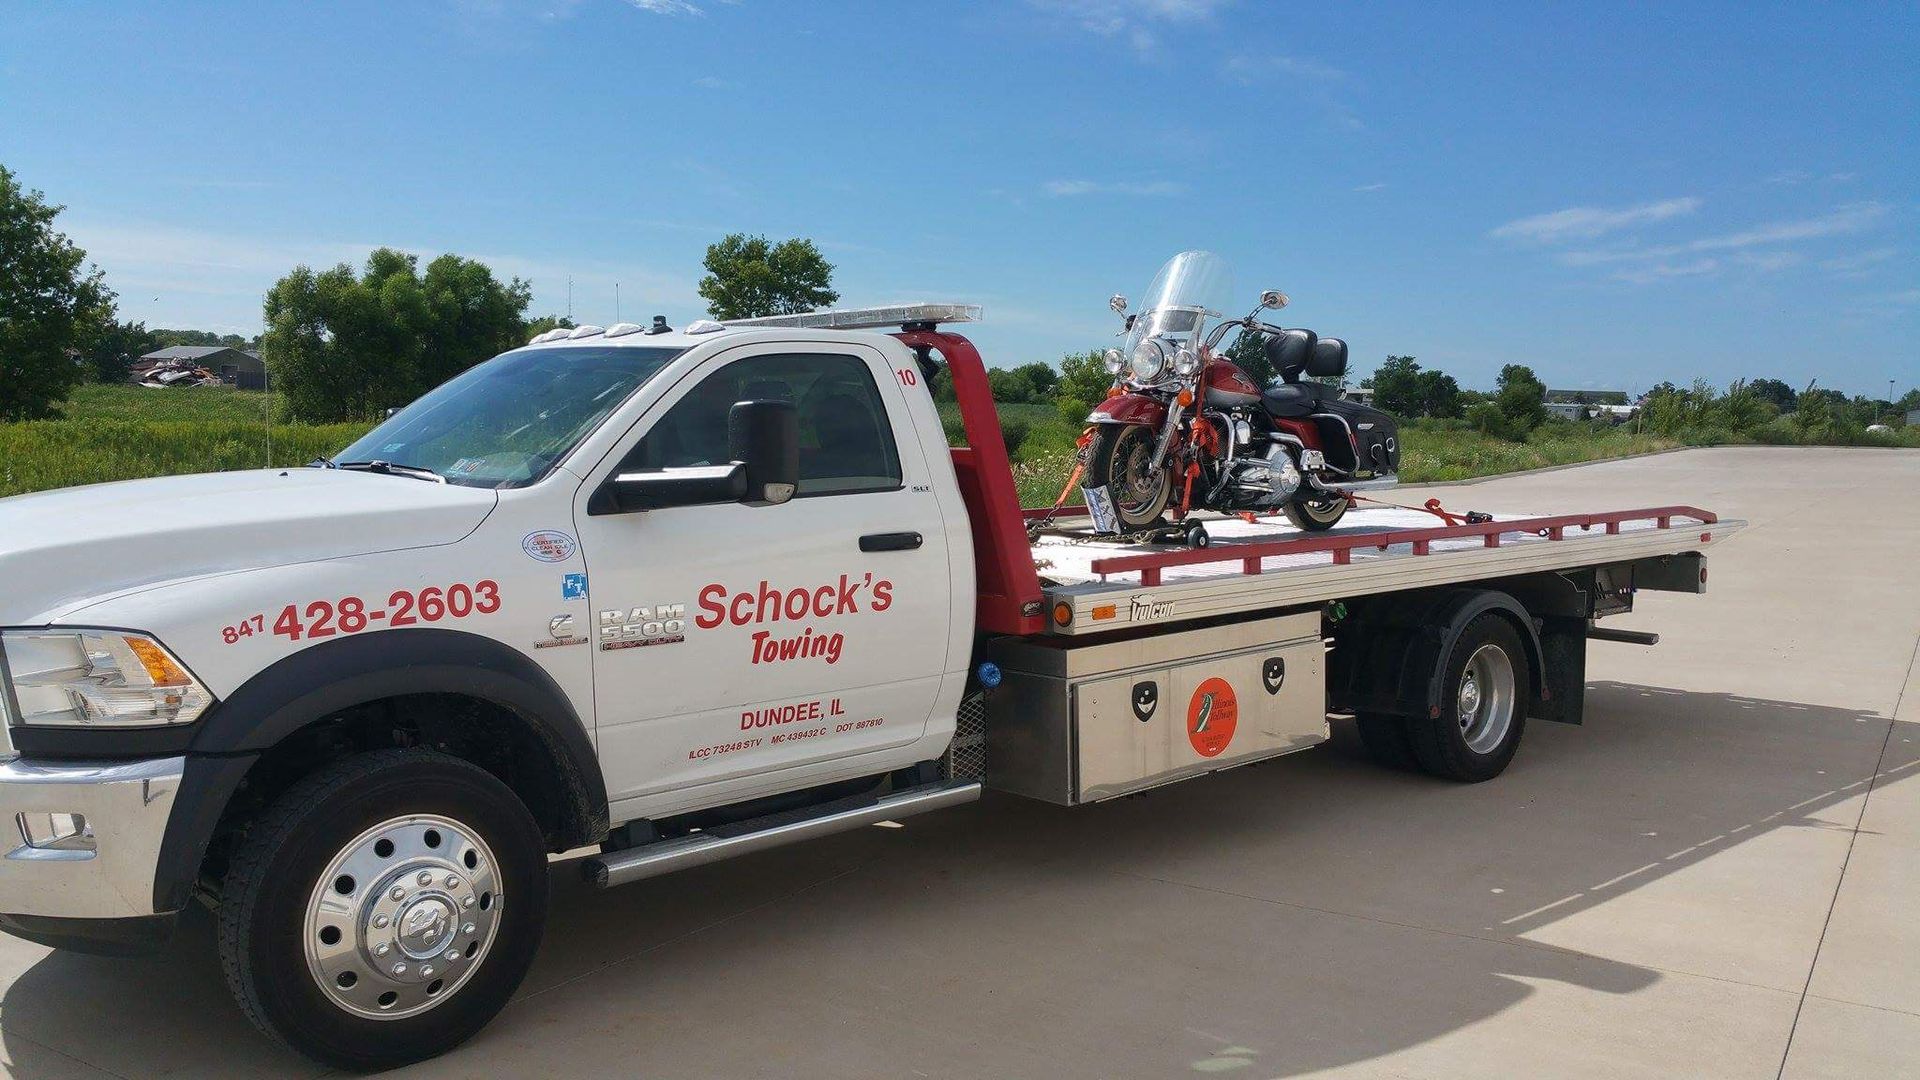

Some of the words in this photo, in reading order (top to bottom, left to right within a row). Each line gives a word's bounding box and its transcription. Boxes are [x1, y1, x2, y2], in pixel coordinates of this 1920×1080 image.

[897, 369, 917, 386] 10
[222, 614, 264, 644] 847
[272, 579, 501, 641] 428-2603
[599, 604, 685, 625] RAM
[694, 571, 894, 630] Schock's
[600, 619, 686, 641] 5500
[751, 626, 845, 666] Towing
[740, 702, 825, 731] DUNDEE,
[829, 698, 845, 716] IL
[688, 748, 711, 760] ILCC
[770, 733, 786, 745] MC
[835, 722, 854, 734] DOT
